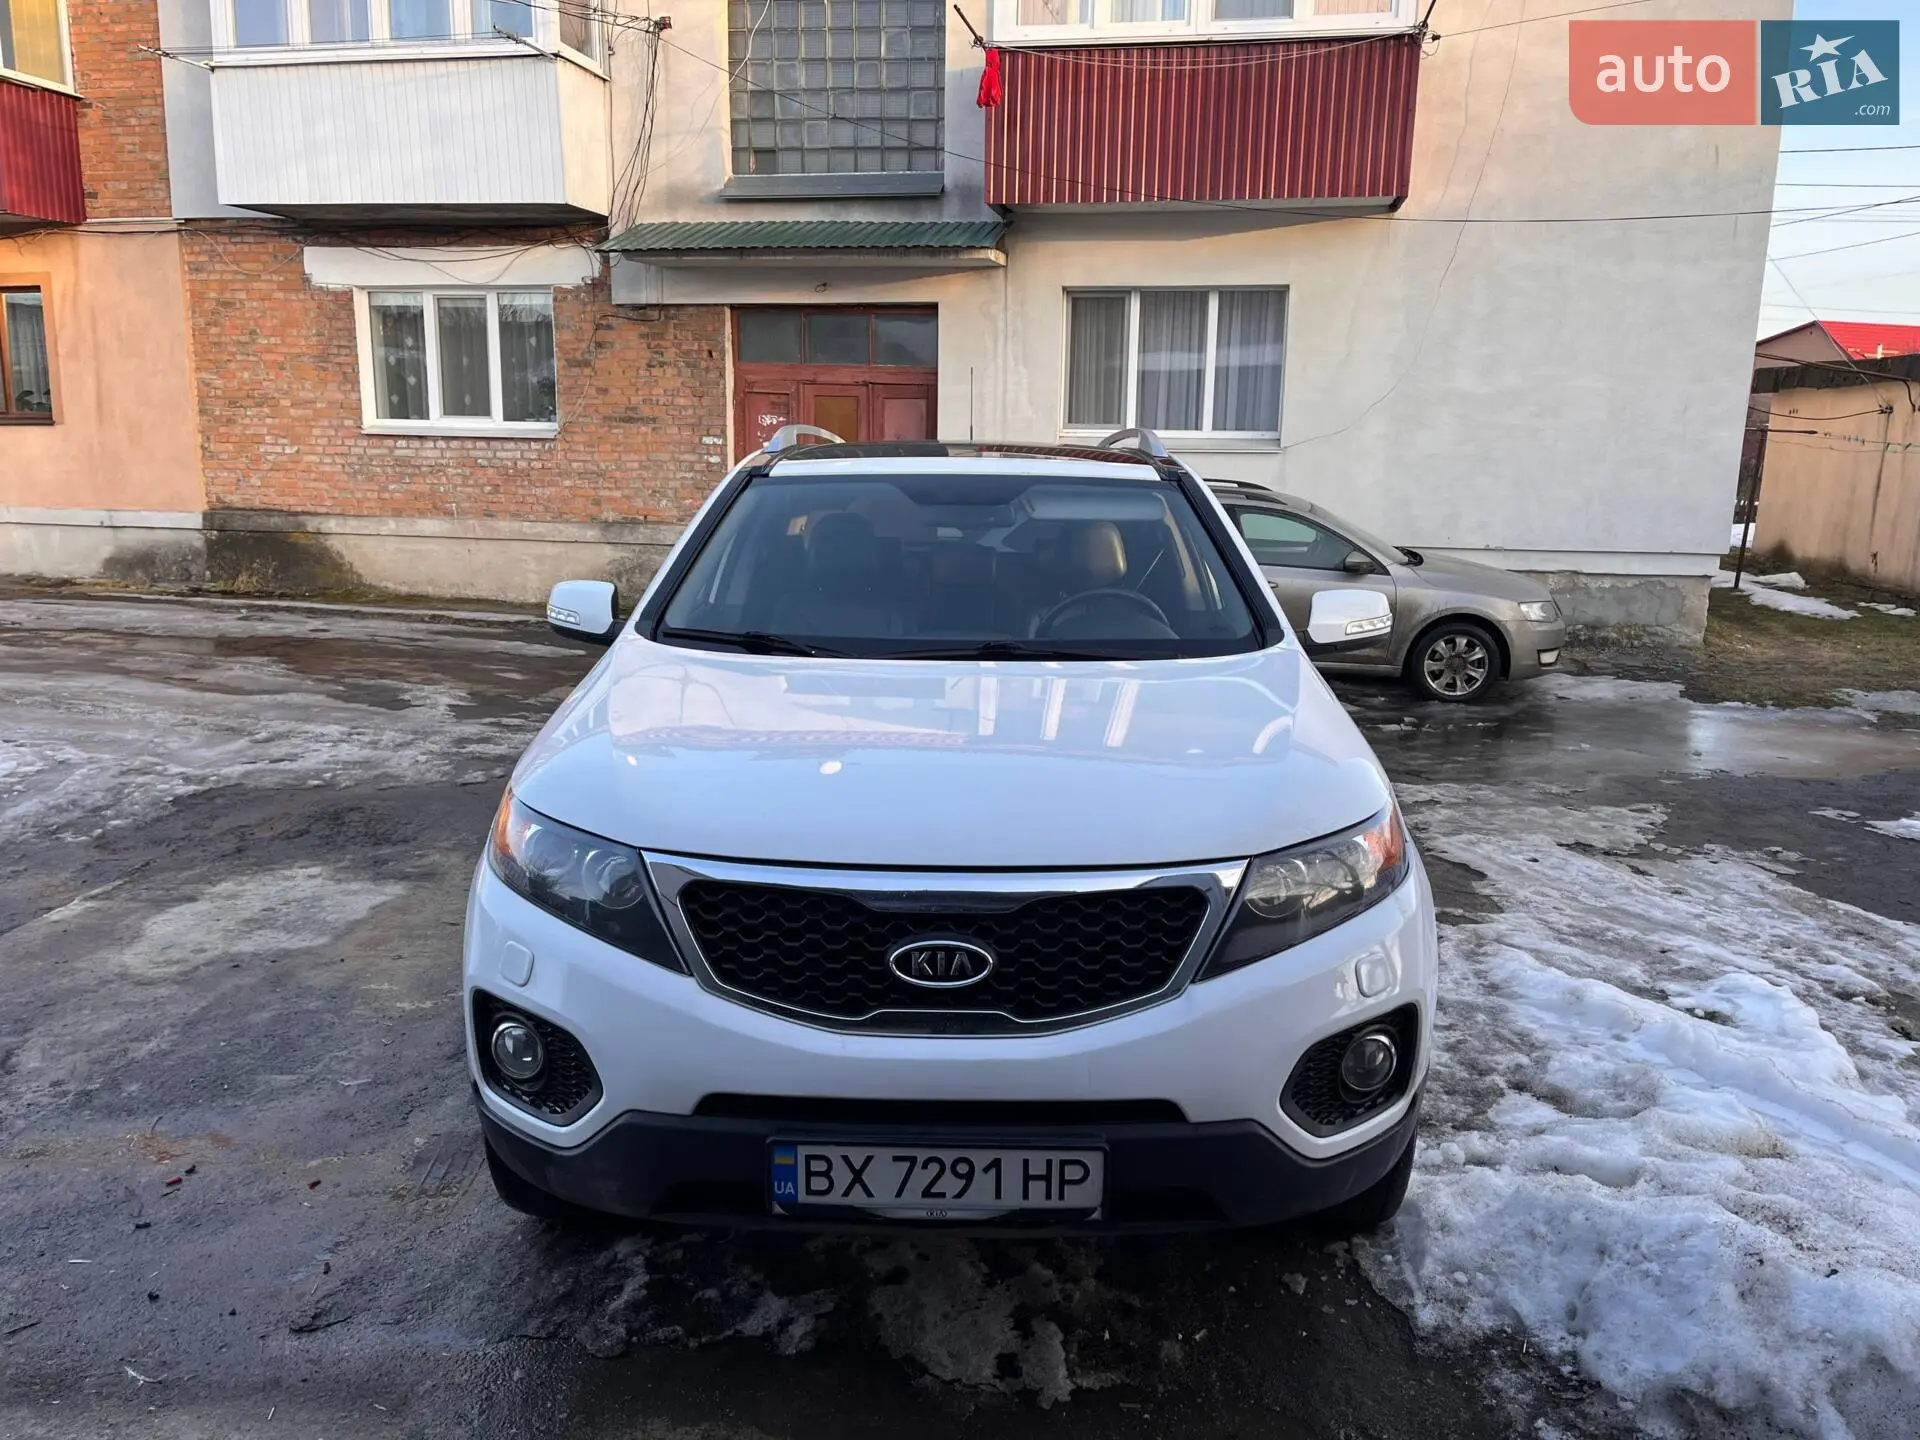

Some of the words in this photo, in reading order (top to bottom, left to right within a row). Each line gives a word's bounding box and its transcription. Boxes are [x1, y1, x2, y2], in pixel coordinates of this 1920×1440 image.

[911, 951, 974, 976] KIA
[774, 1181, 795, 1195] UA
[804, 1154, 875, 1198] BX
[891, 1155, 1002, 1200] 7291
[1022, 1158, 1090, 1201] HP
